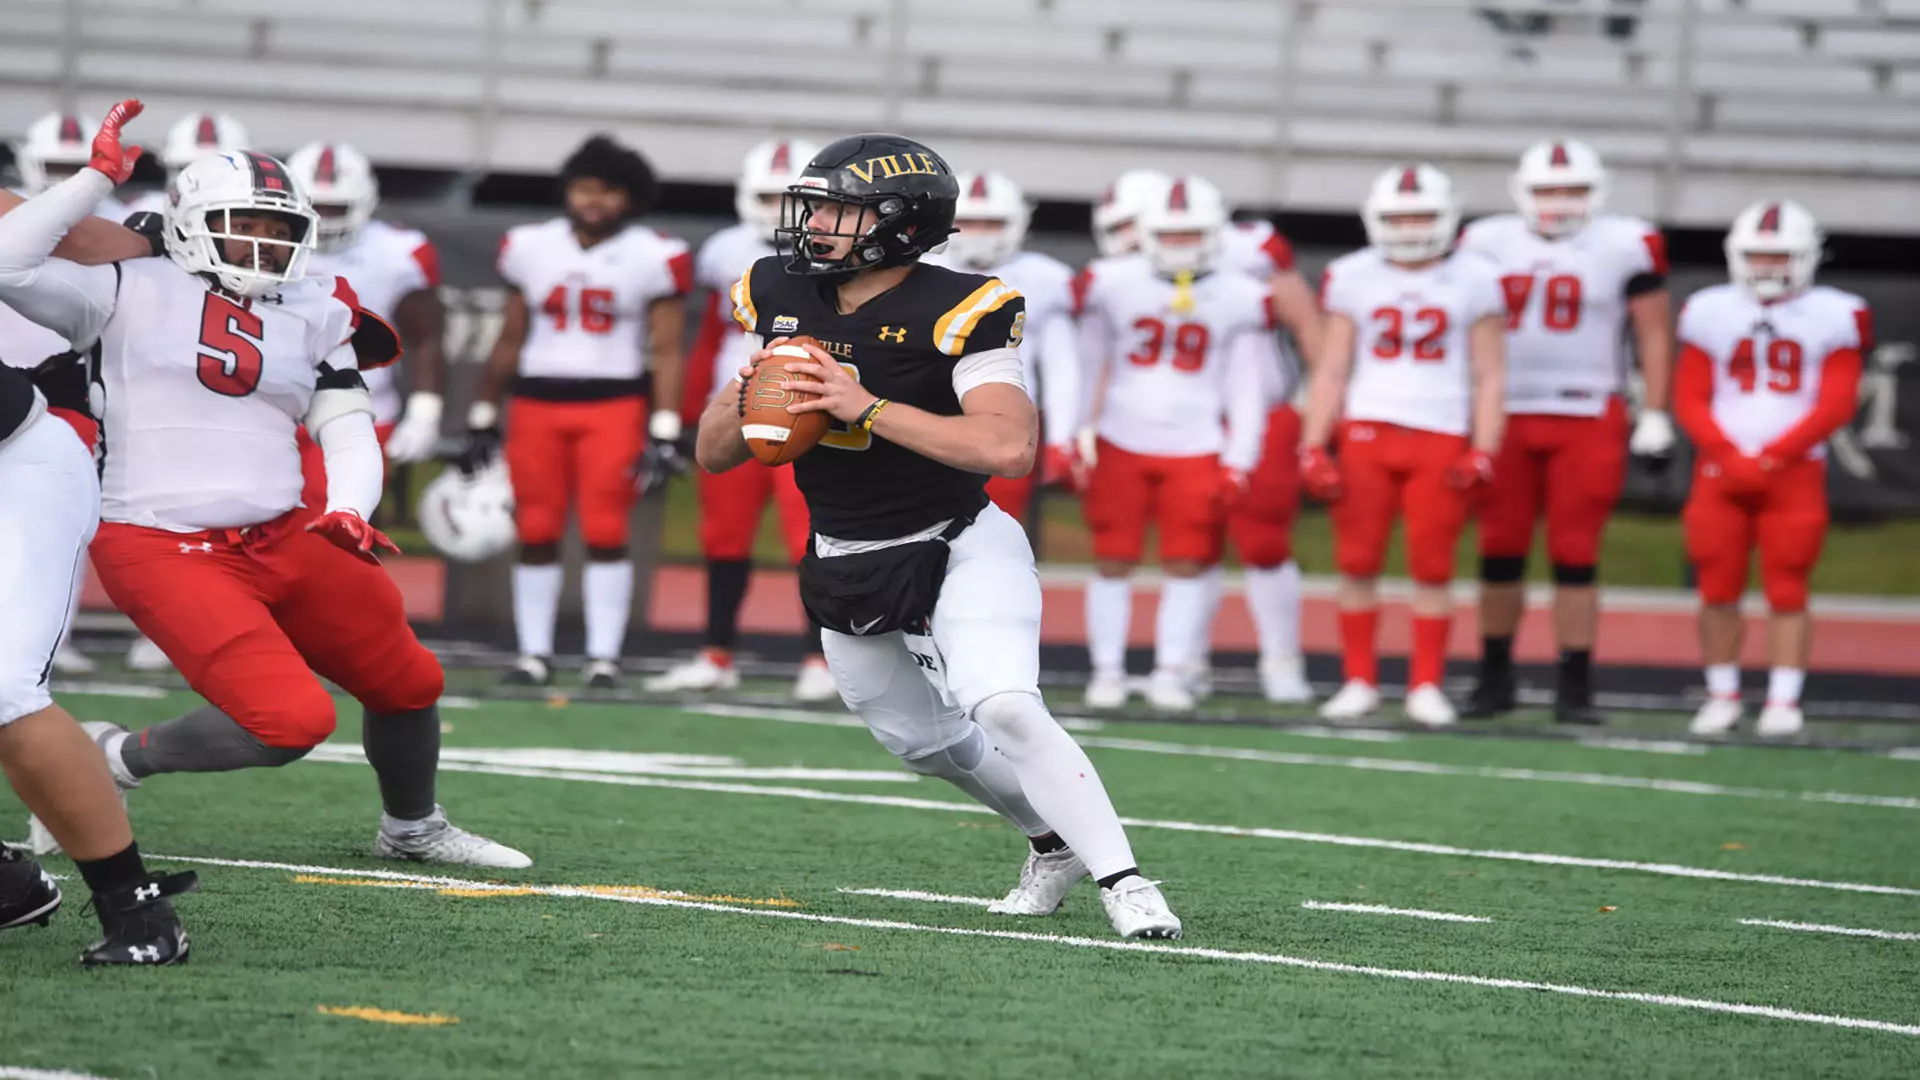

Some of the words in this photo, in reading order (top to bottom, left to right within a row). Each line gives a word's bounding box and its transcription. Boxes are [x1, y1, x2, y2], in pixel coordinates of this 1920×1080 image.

[845, 153, 938, 185] VILLE
[543, 284, 615, 335] 46
[1499, 274, 1582, 332] 78
[197, 291, 263, 397] 5
[819, 340, 853, 358] ILLE
[1127, 316, 1208, 373] 39
[1371, 306, 1447, 361] 32
[1729, 338, 1801, 393] 49
